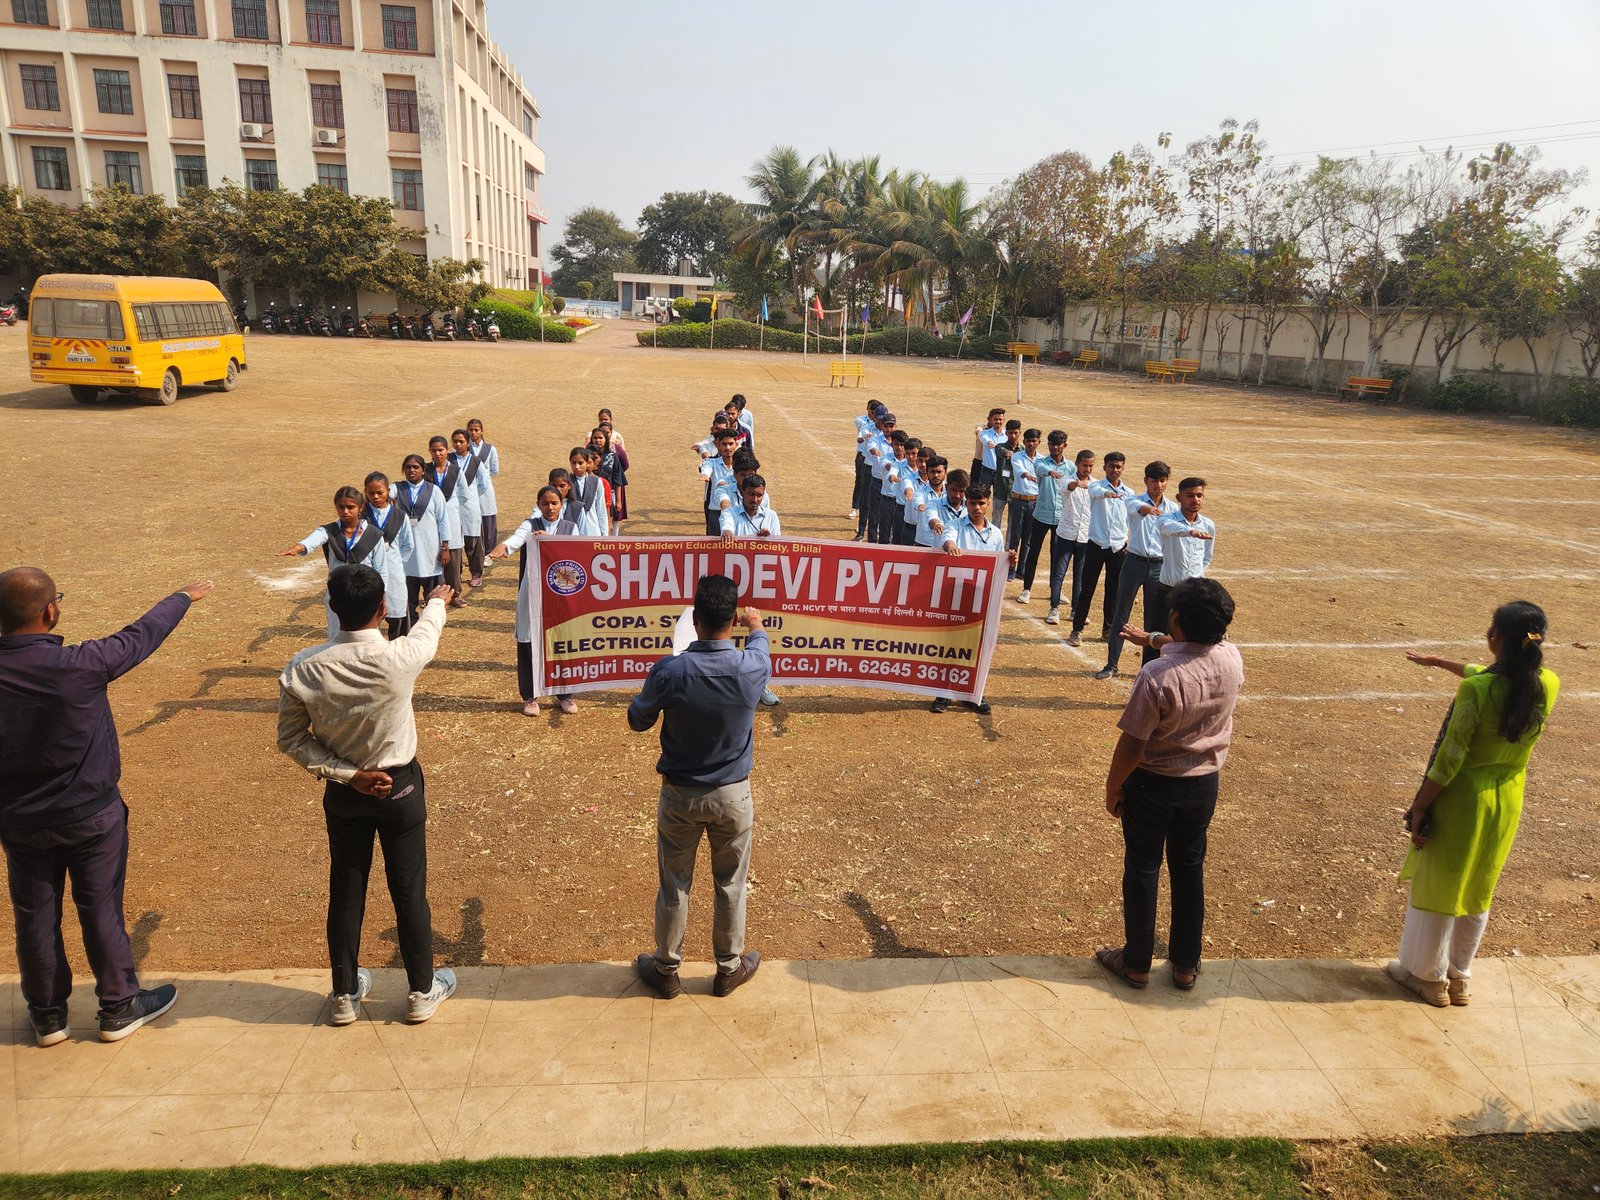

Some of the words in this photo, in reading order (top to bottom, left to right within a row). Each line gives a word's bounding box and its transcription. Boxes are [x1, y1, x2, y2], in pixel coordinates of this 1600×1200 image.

[594, 542, 615, 550] Run
[619, 541, 632, 551] by
[635, 541, 683, 550] Shaildevi
[686, 541, 747, 550] Educational
[750, 541, 789, 553] Society,
[792, 544, 822, 554] Bhilai
[834, 558, 920, 606] PVT
[929, 565, 988, 614] ITI
[781, 603, 800, 612] DGT,
[802, 604, 826, 612] NCVT
[840, 605, 856, 613] भारत
[858, 606, 881, 615] सरकार
[882, 605, 891, 616] नई
[916, 609, 923, 618] से
[592, 615, 647, 629] COPA
[553, 636, 673, 655] ELECTRICIA
[781, 635, 846, 650] SOLAR
[851, 637, 972, 661] TECHNICIAN
[551, 658, 617, 680] Janjgiri
[623, 658, 655, 673] Roa
[775, 657, 820, 674] (C.G.)
[825, 657, 853, 673] Ph.
[858, 659, 912, 678] 62645
[916, 664, 970, 686] 36162
